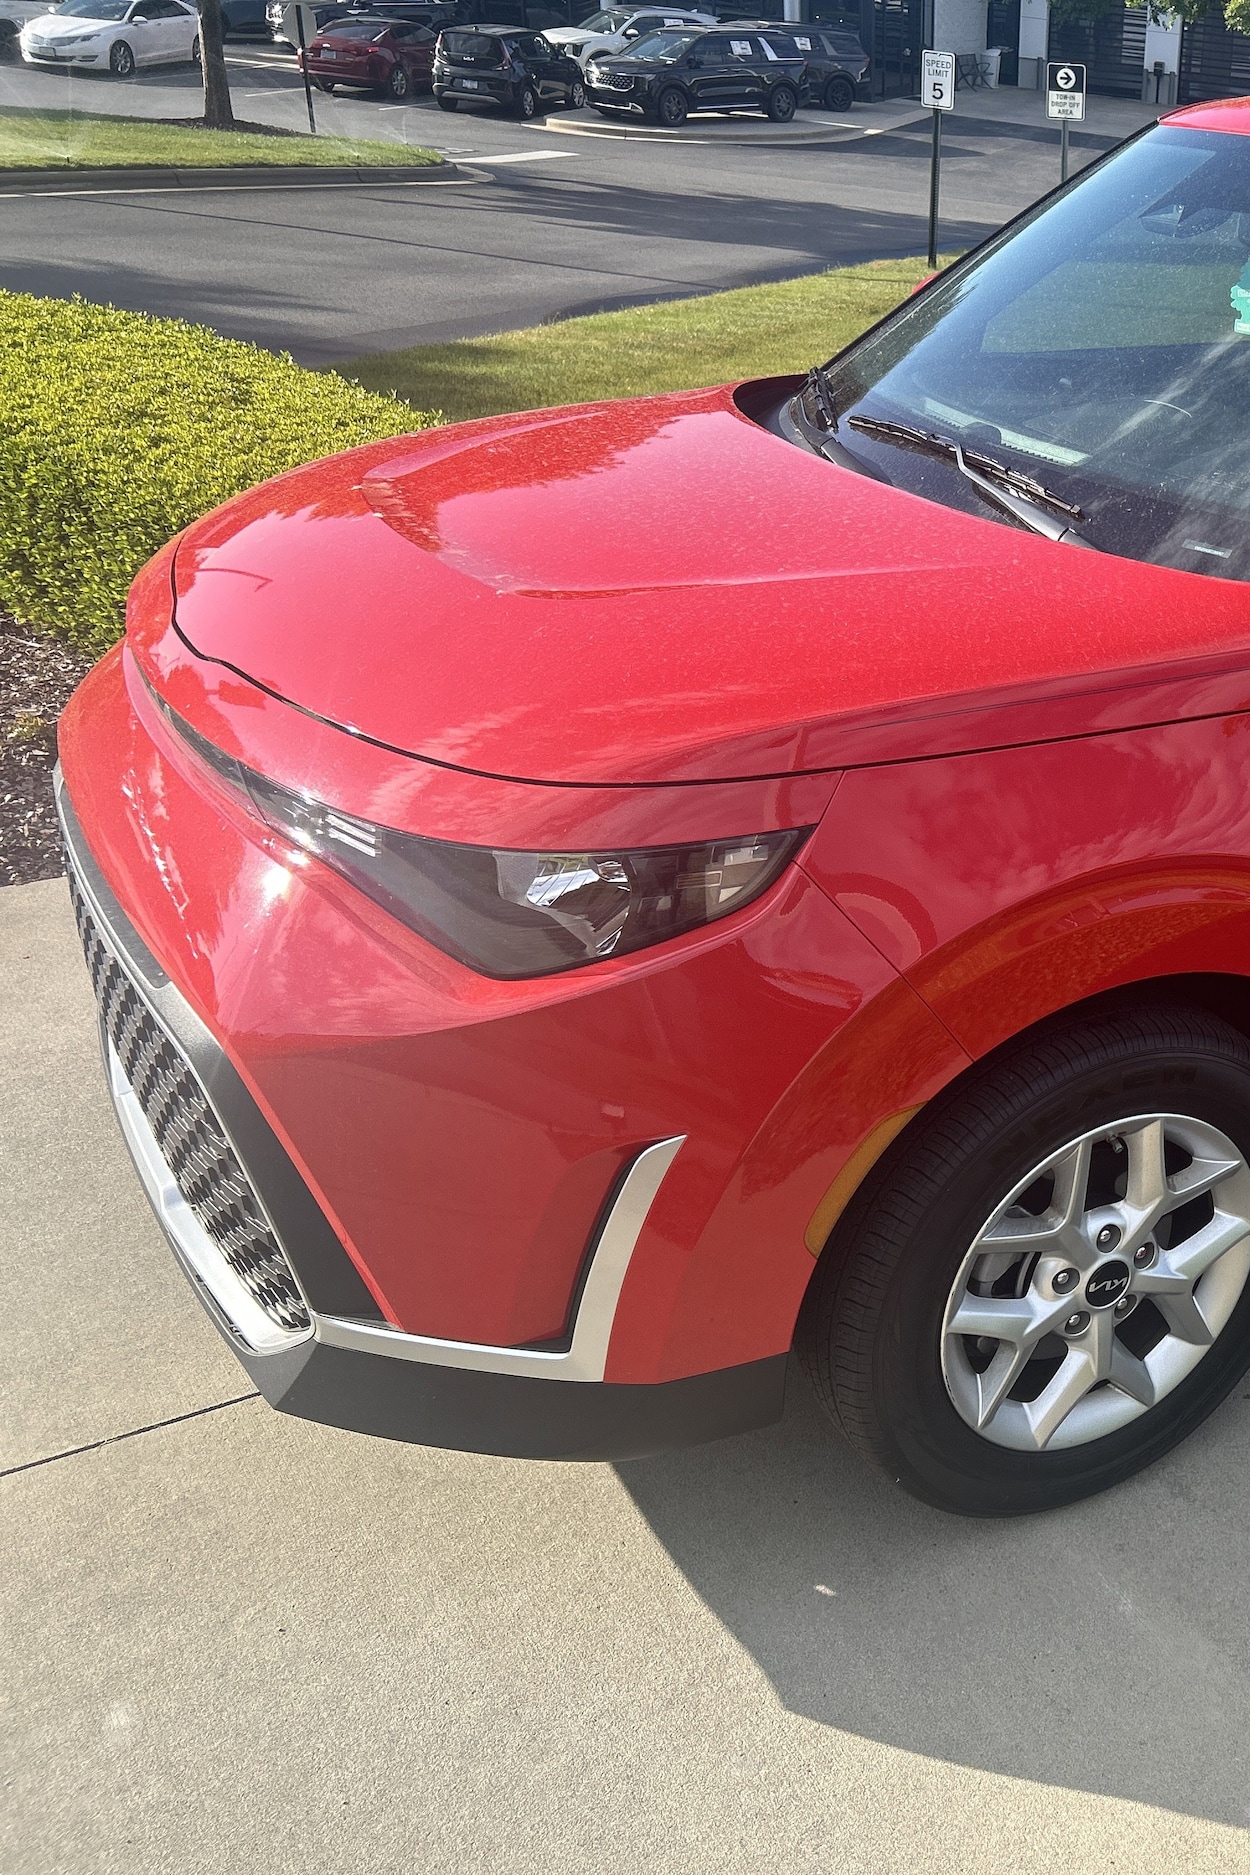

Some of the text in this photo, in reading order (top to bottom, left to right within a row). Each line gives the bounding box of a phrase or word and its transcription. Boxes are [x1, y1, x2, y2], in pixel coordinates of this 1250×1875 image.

[925, 59, 952, 69] SPEED
[928, 69, 949, 78] LIMIT
[932, 82, 944, 100] 5
[1056, 93, 1076, 101] TOW-IN
[1051, 100, 1068, 108] DROP
[1058, 108, 1074, 116] AREA
